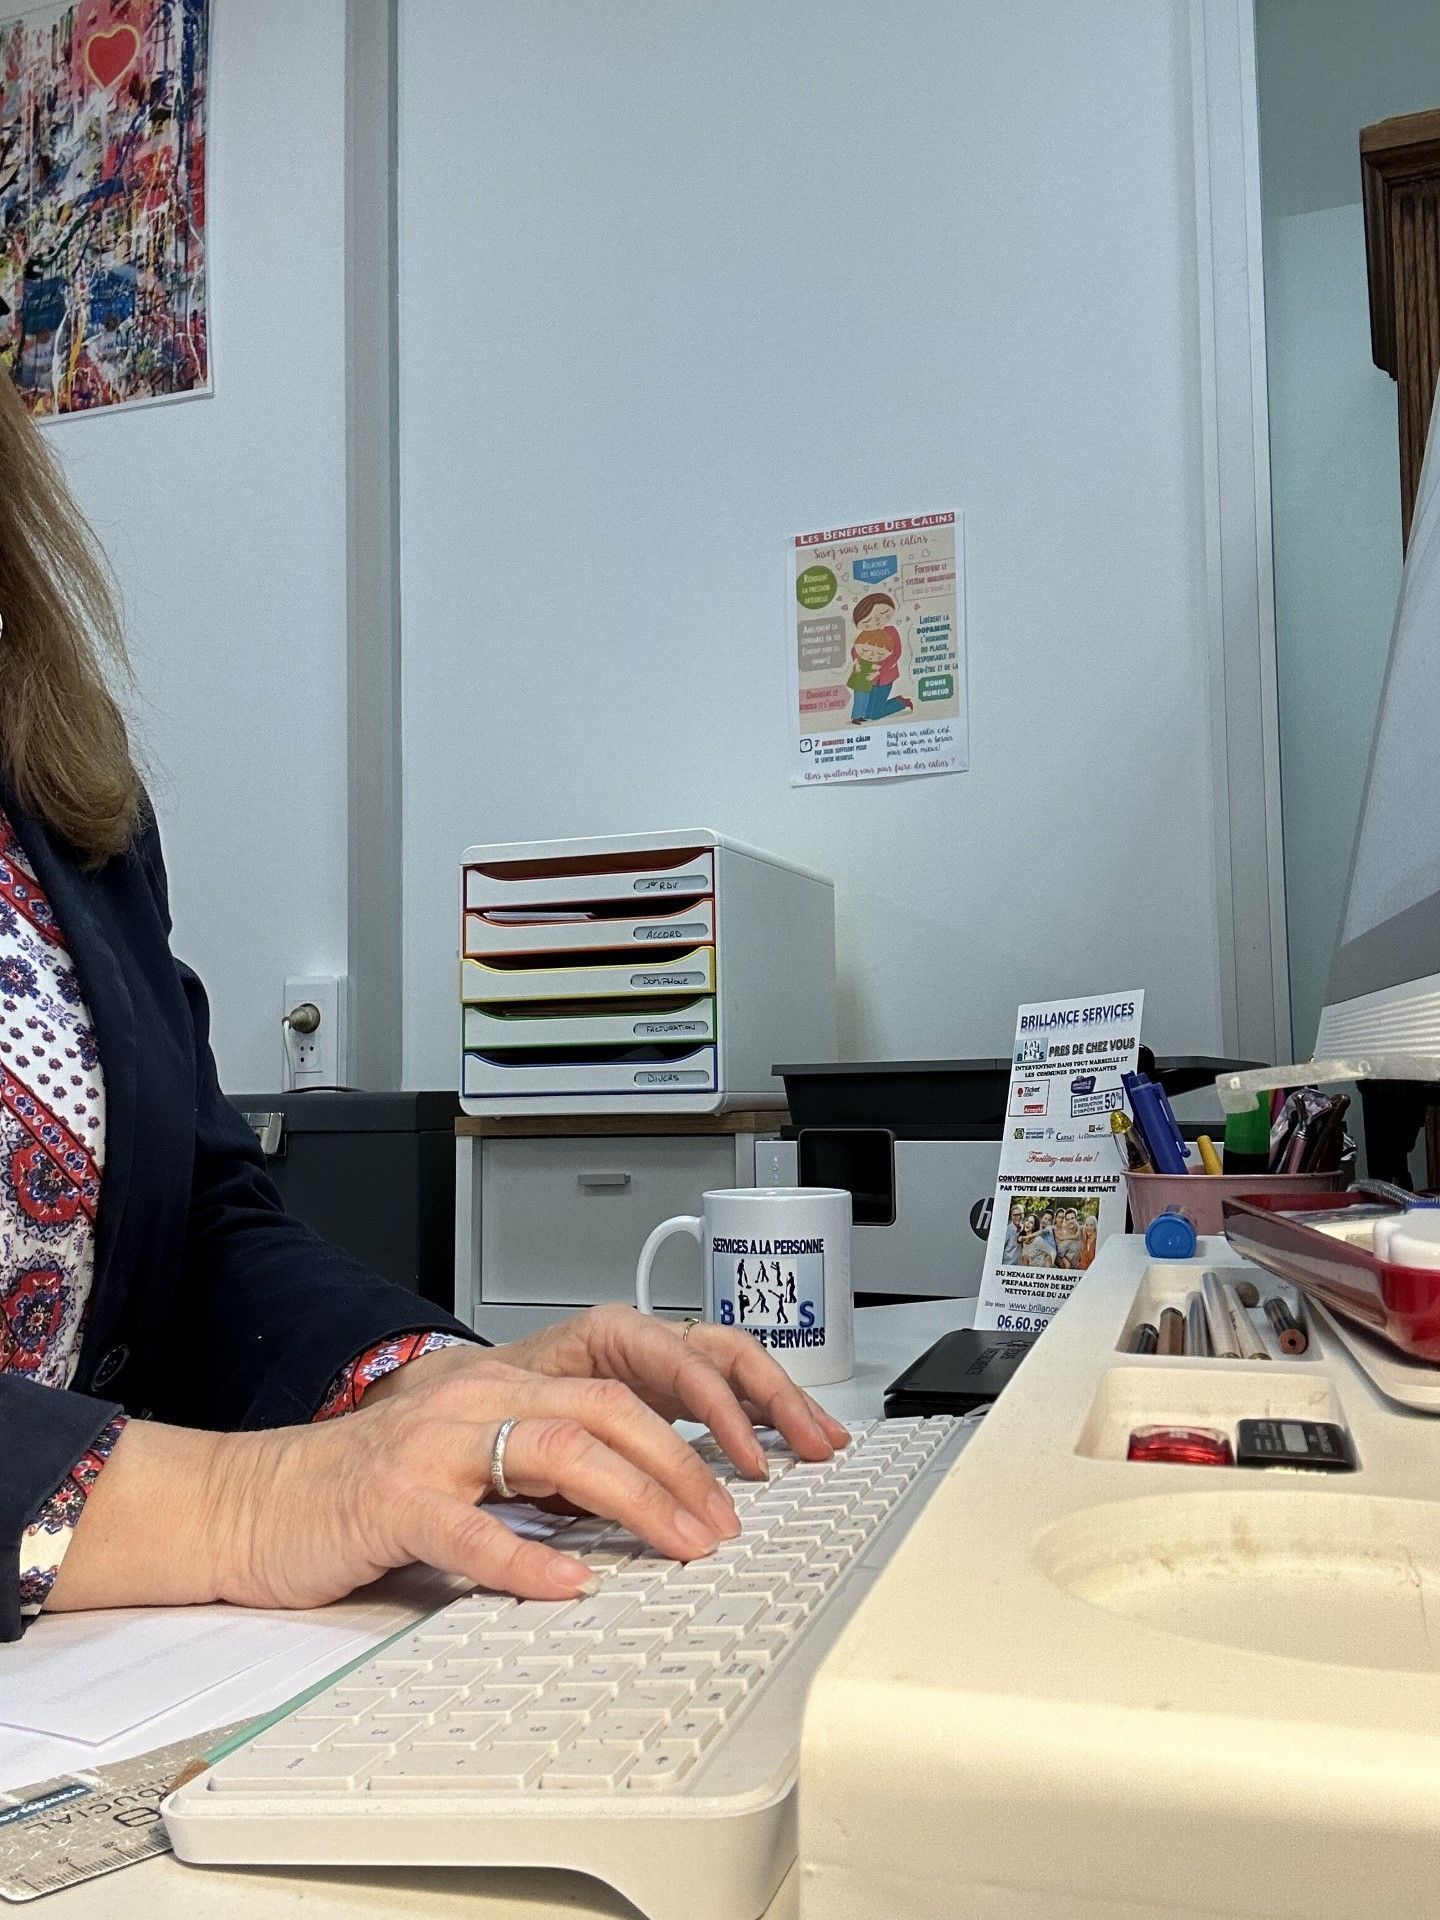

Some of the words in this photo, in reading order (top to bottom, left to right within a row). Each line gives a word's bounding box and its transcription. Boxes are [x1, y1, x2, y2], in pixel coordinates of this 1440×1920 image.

[863, 542, 878, 552] que
[883, 537, 896, 548] les
[646, 930, 683, 939] ACCORD
[1020, 1010, 1080, 1029] BRILLANCE
[1082, 1002, 1135, 1021] SERVICES
[1072, 1043, 1084, 1055] DE
[1086, 1041, 1108, 1053] CHEZ
[1109, 1037, 1135, 1051] VOUS
[1015, 1063, 1057, 1071] INTERVENTION
[1069, 1065, 1117, 1075] ENVIRONNANTES
[1055, 1175, 1073, 1183] DANS
[1074, 1175, 1083, 1183] LE
[1093, 1175, 1101, 1183] ET
[1103, 1175, 1111, 1183] LE
[713, 1237, 749, 1253] SERVICES
[750, 1240, 757, 1254] A
[759, 1240, 772, 1254] LA
[774, 1238, 824, 1254] PERSONNE
[1006, 1271, 1034, 1279] MENAGE
[1046, 1274, 1077, 1282] PASSANT
[1001, 1279, 1049, 1289] PREPARATION
[1060, 1283, 1074, 1291] REP
[1004, 1287, 1045, 1297] NETTOYAGE
[720, 1299, 735, 1325] B
[799, 1300, 815, 1328] S
[997, 1314, 1049, 1332] 06.60.99
[770, 1327, 826, 1348] SERVICES
[24, 1783, 172, 1831] IDUCIAL
